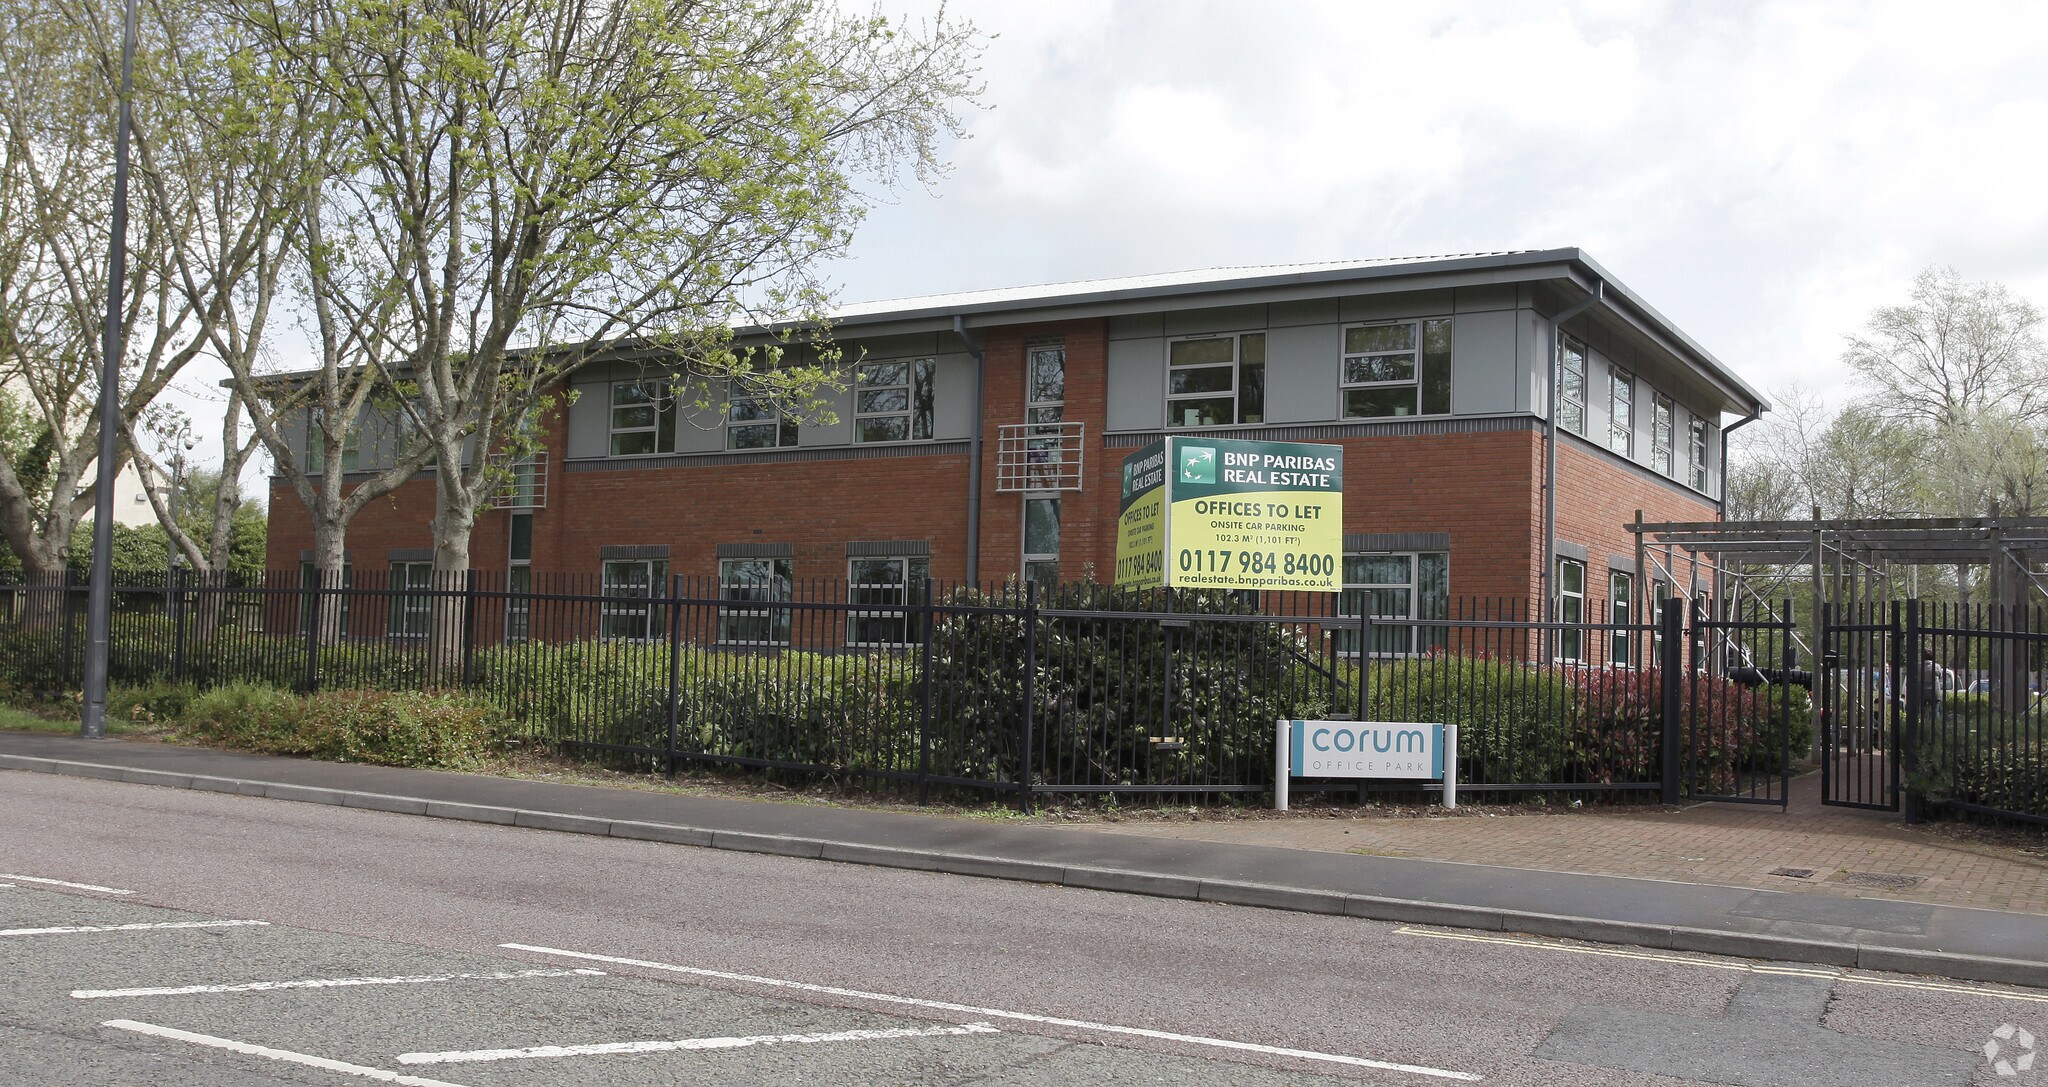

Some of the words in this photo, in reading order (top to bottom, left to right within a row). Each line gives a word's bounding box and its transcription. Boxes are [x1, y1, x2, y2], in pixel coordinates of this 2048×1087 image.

[1133, 461, 1143, 476] BNP
[1143, 451, 1164, 471] PARIBAS
[1224, 452, 1260, 467] BNP
[1263, 454, 1335, 471] PARIBAS
[1132, 476, 1144, 492] REAL
[1144, 469, 1162, 487] ESTATE
[1224, 469, 1267, 484] REAL
[1270, 471, 1330, 487] ESTATE
[1142, 505, 1150, 519] TO
[1150, 502, 1159, 517] LET
[1195, 500, 1262, 517] OFFICES
[1267, 503, 1289, 518] TO
[1295, 505, 1322, 519] LET
[1210, 520, 1243, 530] ONSITE
[1245, 522, 1263, 530] CAR
[1265, 523, 1306, 532] PARKING
[1216, 534, 1239, 543] 102.3
[1255, 535, 1282, 545] (1,101
[1117, 557, 1132, 579] 0117
[1133, 554, 1144, 576] 984
[1146, 549, 1162, 574] 8400
[1179, 548, 1232, 573] 0117
[1239, 550, 1276, 574] 984
[1283, 552, 1335, 577] 8400
[1179, 573, 1333, 588] realestate.bnpparibas.co.uk
[1312, 728, 1424, 753] corum
[1312, 760, 1374, 771] OFFICE
[1386, 762, 1424, 772] PARK
